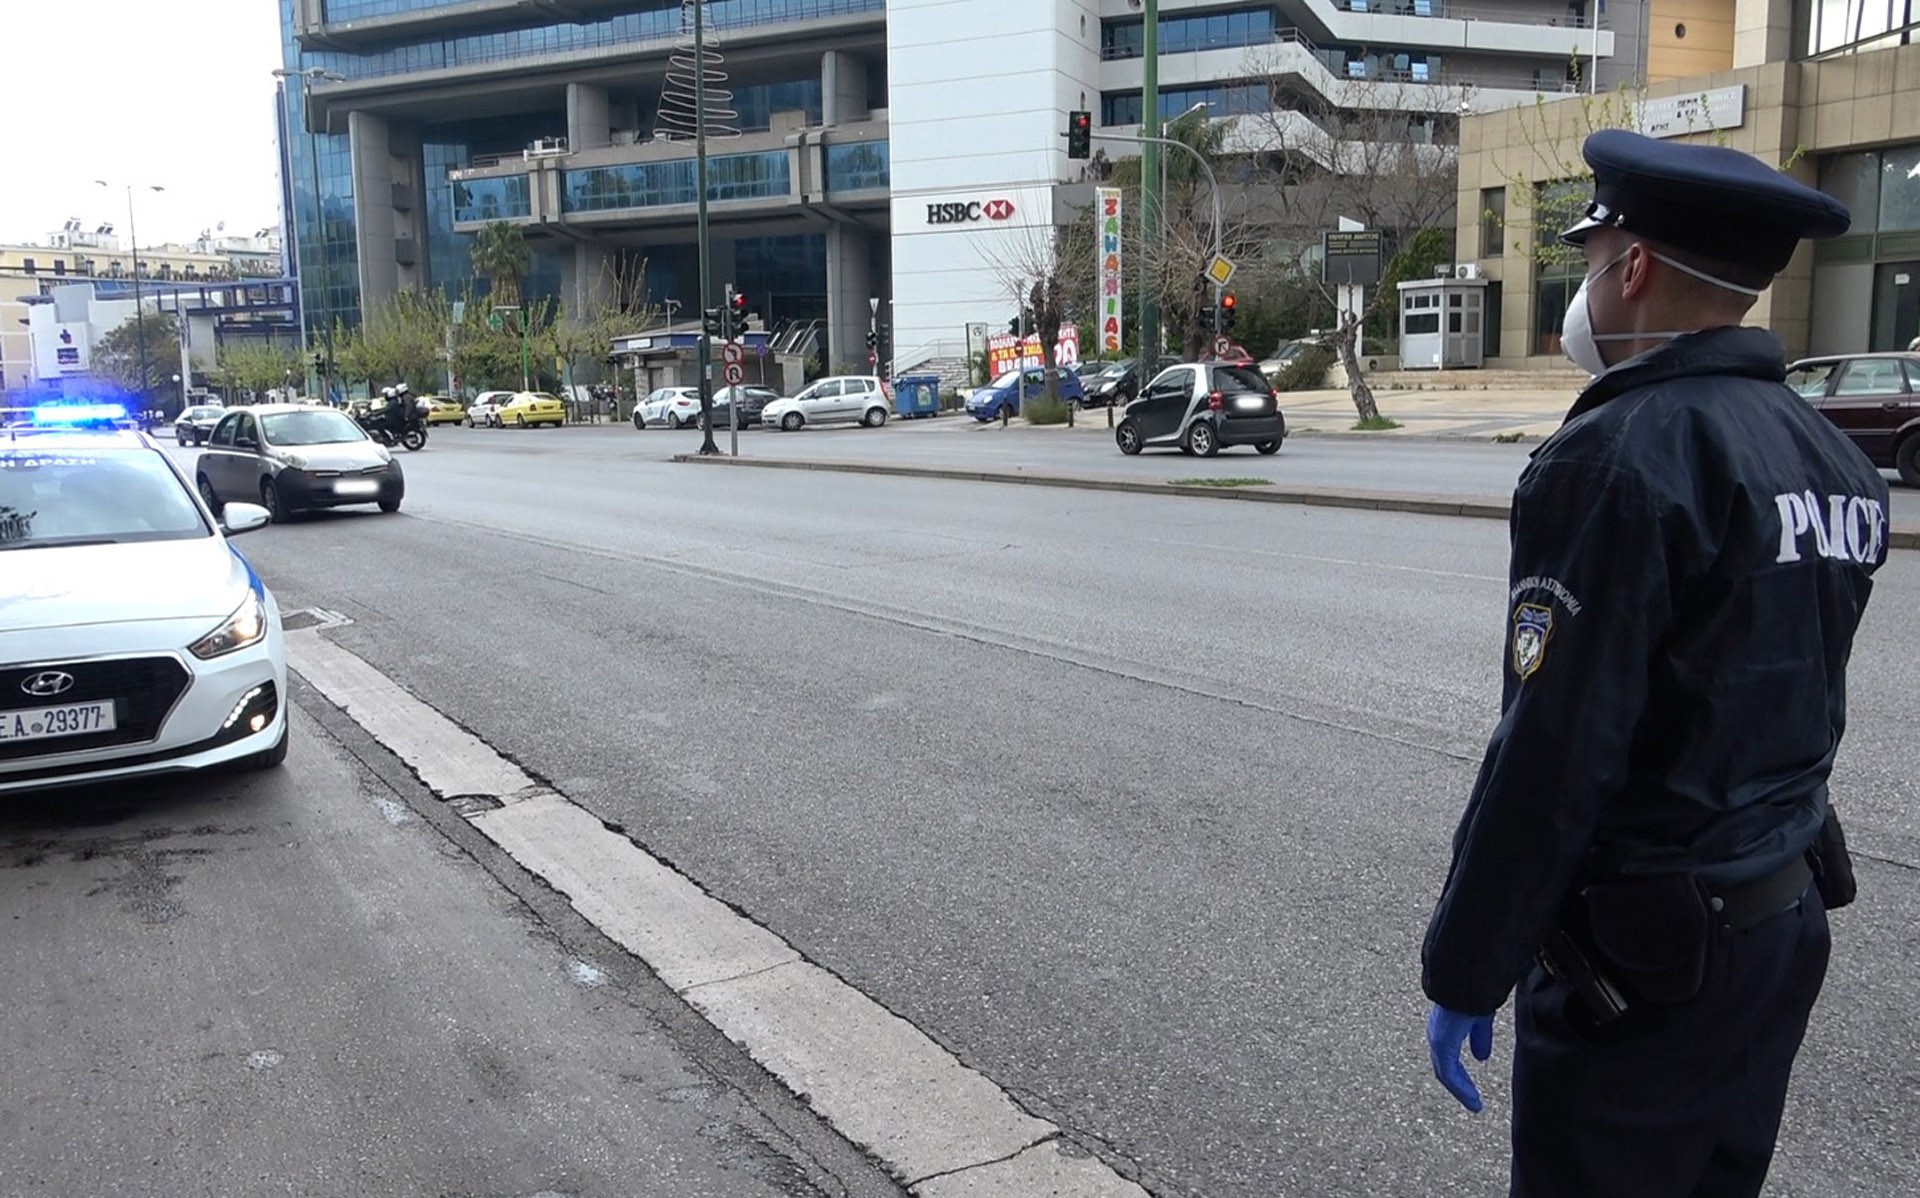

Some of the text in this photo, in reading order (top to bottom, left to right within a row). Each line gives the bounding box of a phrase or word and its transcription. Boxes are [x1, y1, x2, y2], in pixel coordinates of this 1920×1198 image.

[927, 202, 981, 224] HSBC
[1774, 488, 1886, 565] POICE
[44, 705, 101, 734] 29377
